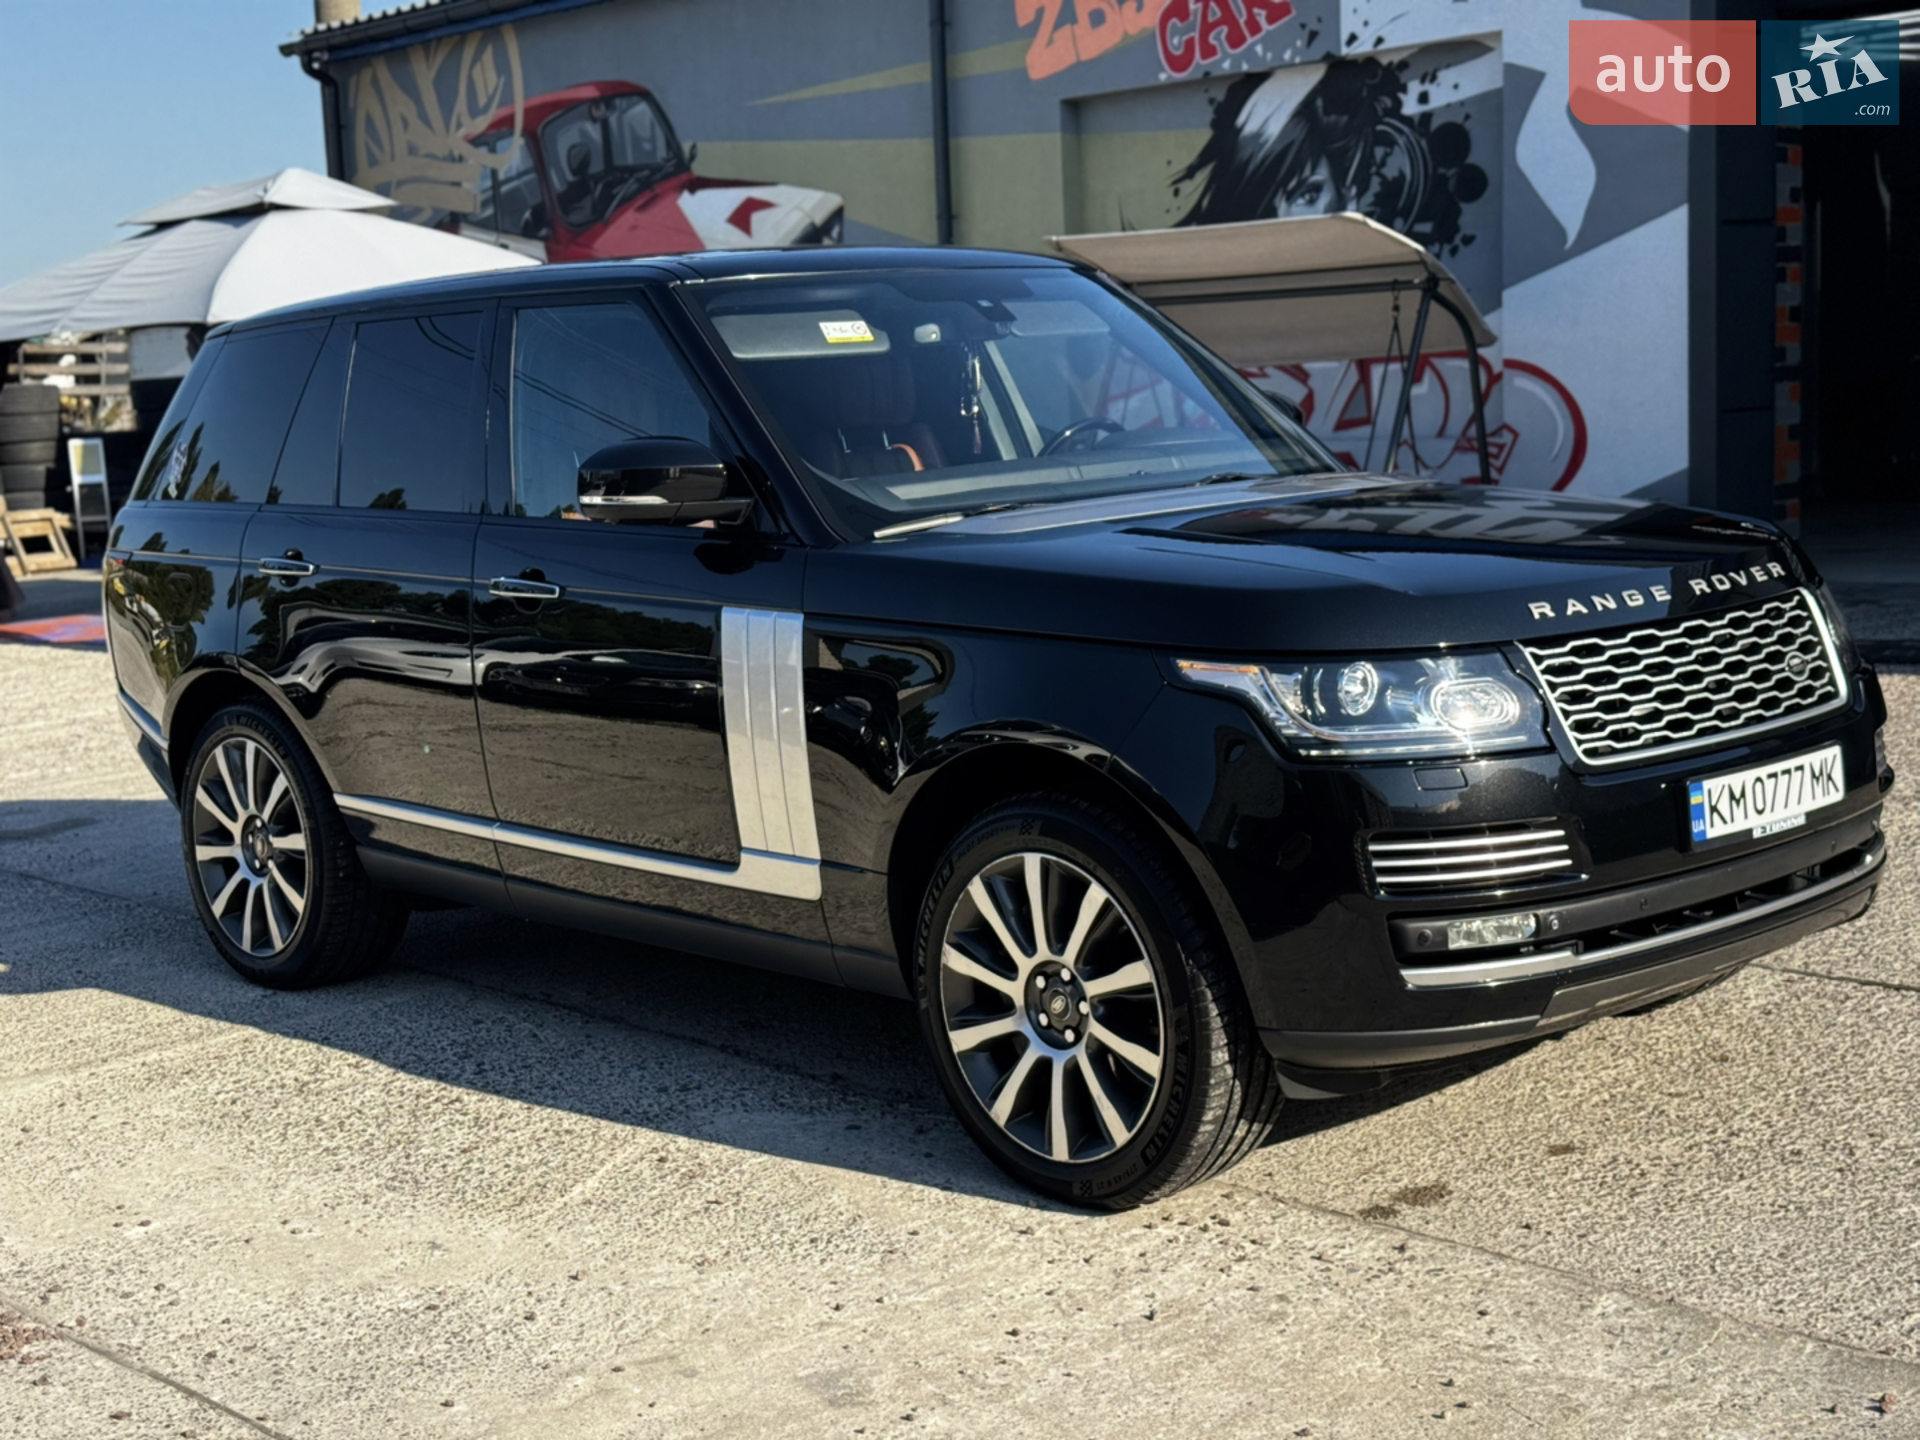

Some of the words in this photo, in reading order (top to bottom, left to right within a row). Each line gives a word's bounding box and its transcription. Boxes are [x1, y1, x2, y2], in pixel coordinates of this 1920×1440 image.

[1527, 584, 1673, 620] RANGE
[1688, 561, 1787, 596] ROVER
[1691, 818, 1706, 833] UA
[917, 863, 952, 968] MICHELIN
[1143, 1052, 1188, 1162] MICHELIN
